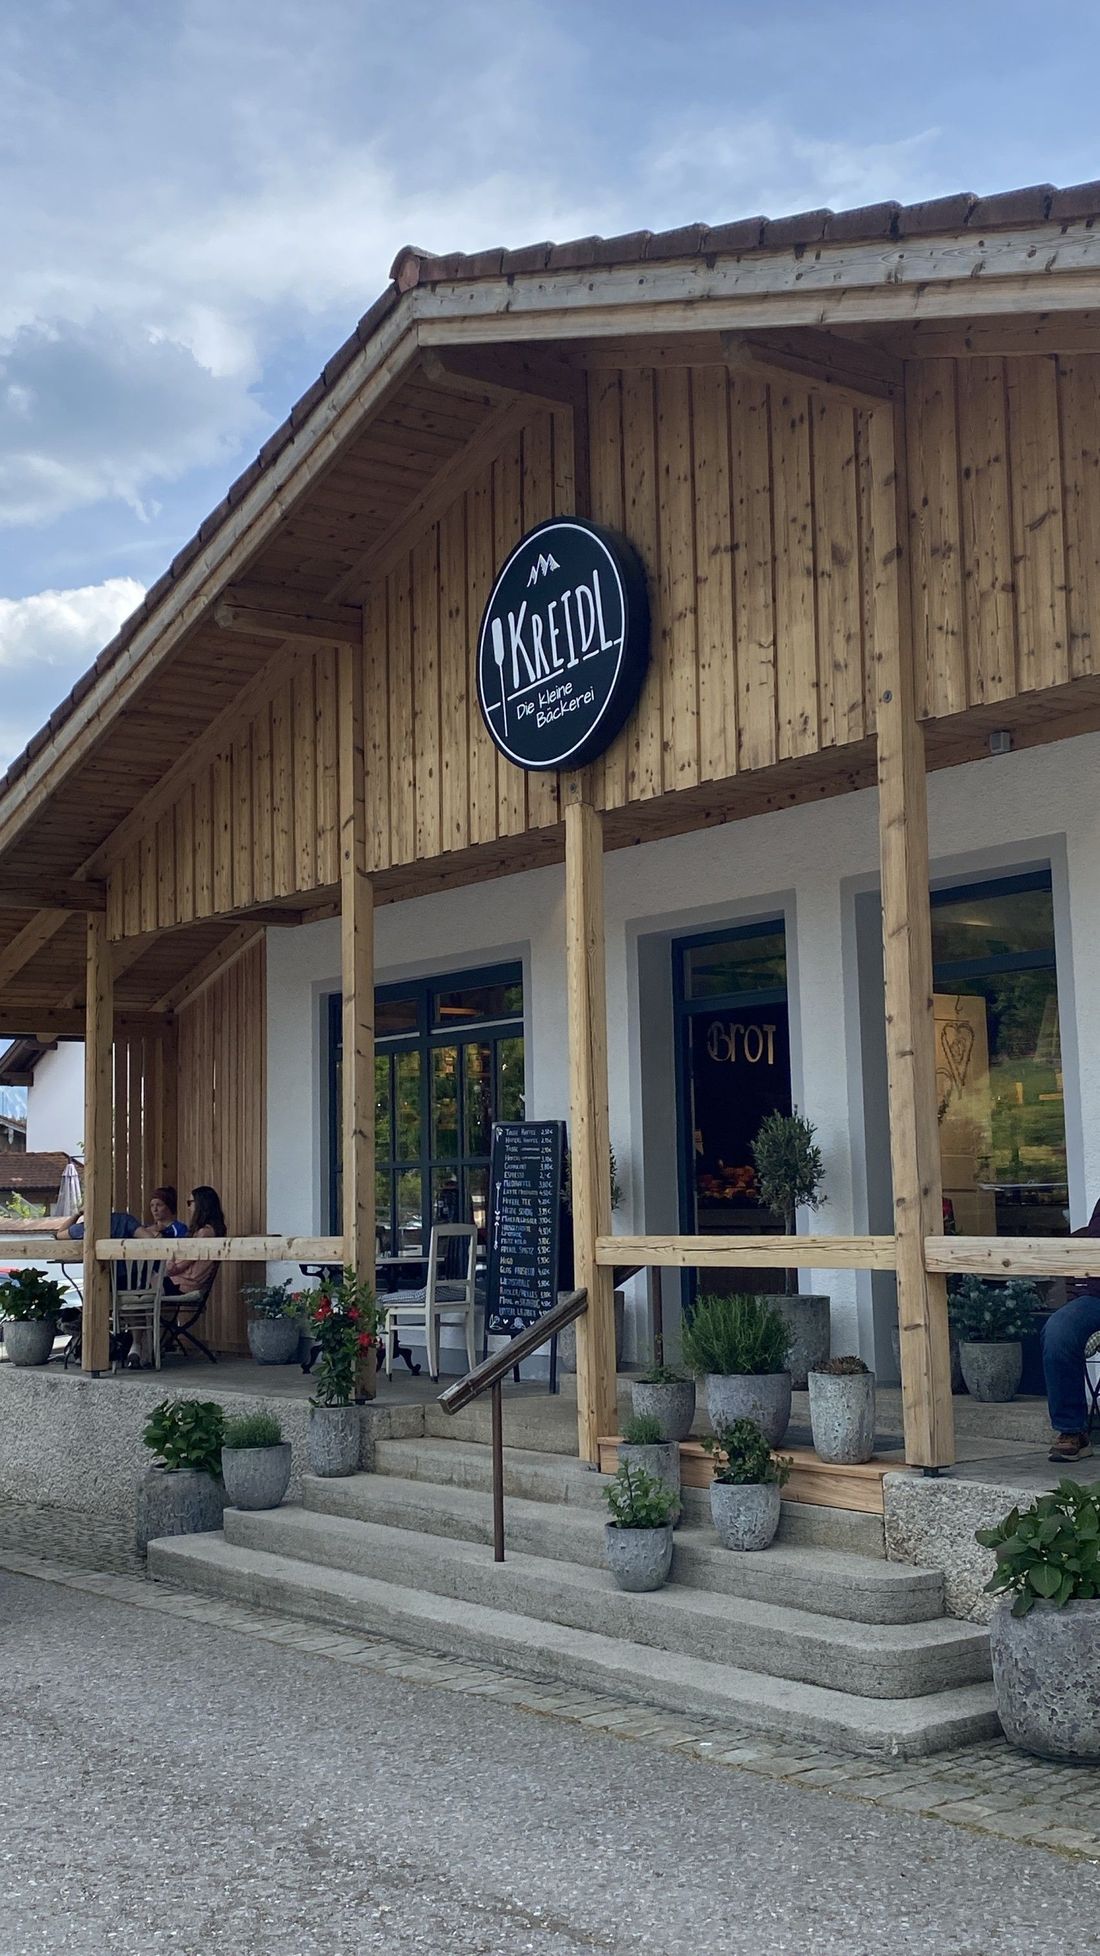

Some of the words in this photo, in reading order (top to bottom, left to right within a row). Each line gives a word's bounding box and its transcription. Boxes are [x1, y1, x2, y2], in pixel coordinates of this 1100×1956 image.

[508, 569, 613, 689] KREIDL
[516, 701, 535, 720] Die
[536, 686, 595, 729] Bäckerei
